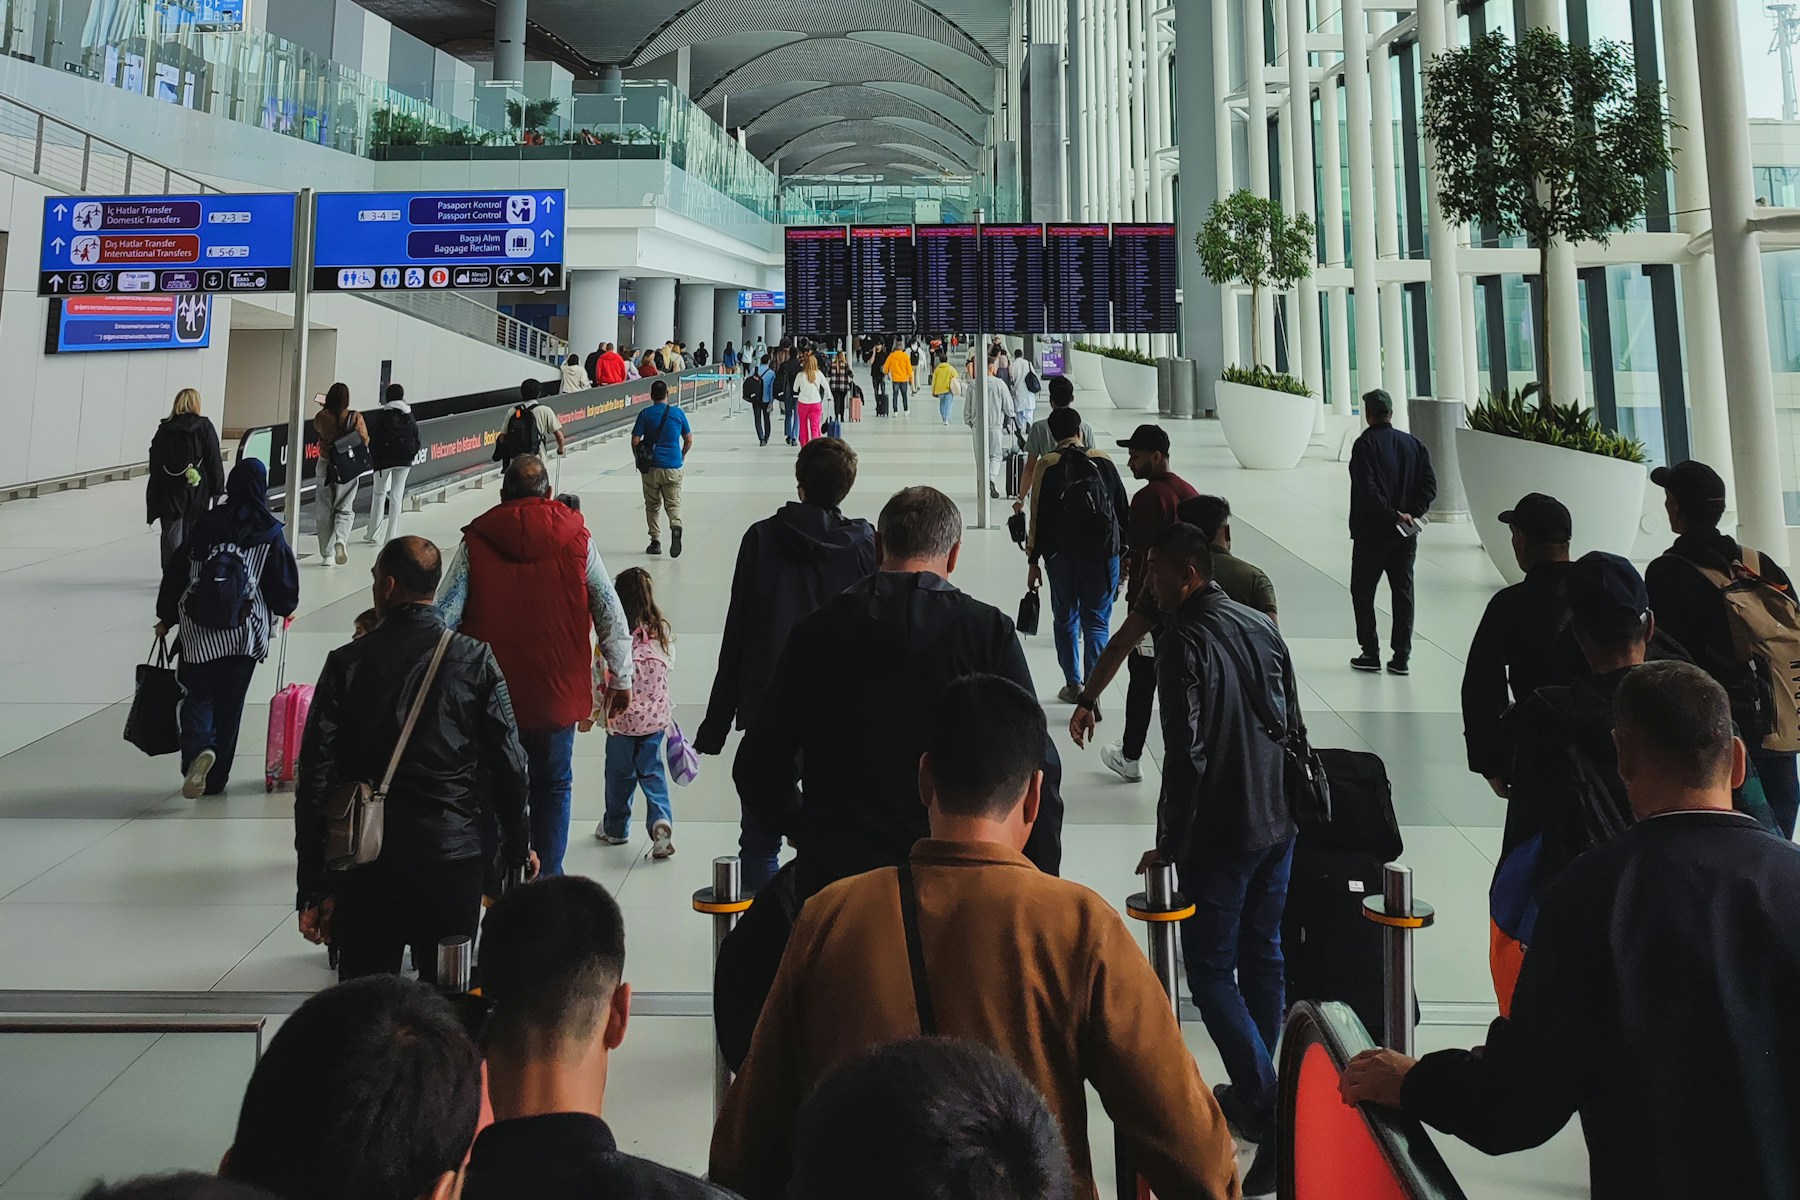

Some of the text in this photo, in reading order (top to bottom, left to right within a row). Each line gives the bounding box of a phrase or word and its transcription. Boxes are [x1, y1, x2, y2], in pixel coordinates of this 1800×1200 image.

[115, 206, 140, 215] Hatlar
[141, 205, 172, 214] Transfer
[437, 200, 502, 211] Pasaport Kontrol
[106, 215, 181, 225] Domestic Transfers
[221, 213, 236, 222] 2-3
[371, 211, 386, 220] 3-4
[437, 211, 502, 221] Passport Control
[119, 239, 143, 248] Hatlar
[144, 239, 176, 248] Transfer
[460, 234, 481, 244] Bagaj
[104, 249, 192, 258] International Transfers
[219, 247, 235, 256] 5-6
[434, 243, 500, 254] Baggage Reclaim
[431, 442, 456, 460] Welcome
[457, 438, 462, 453] to
